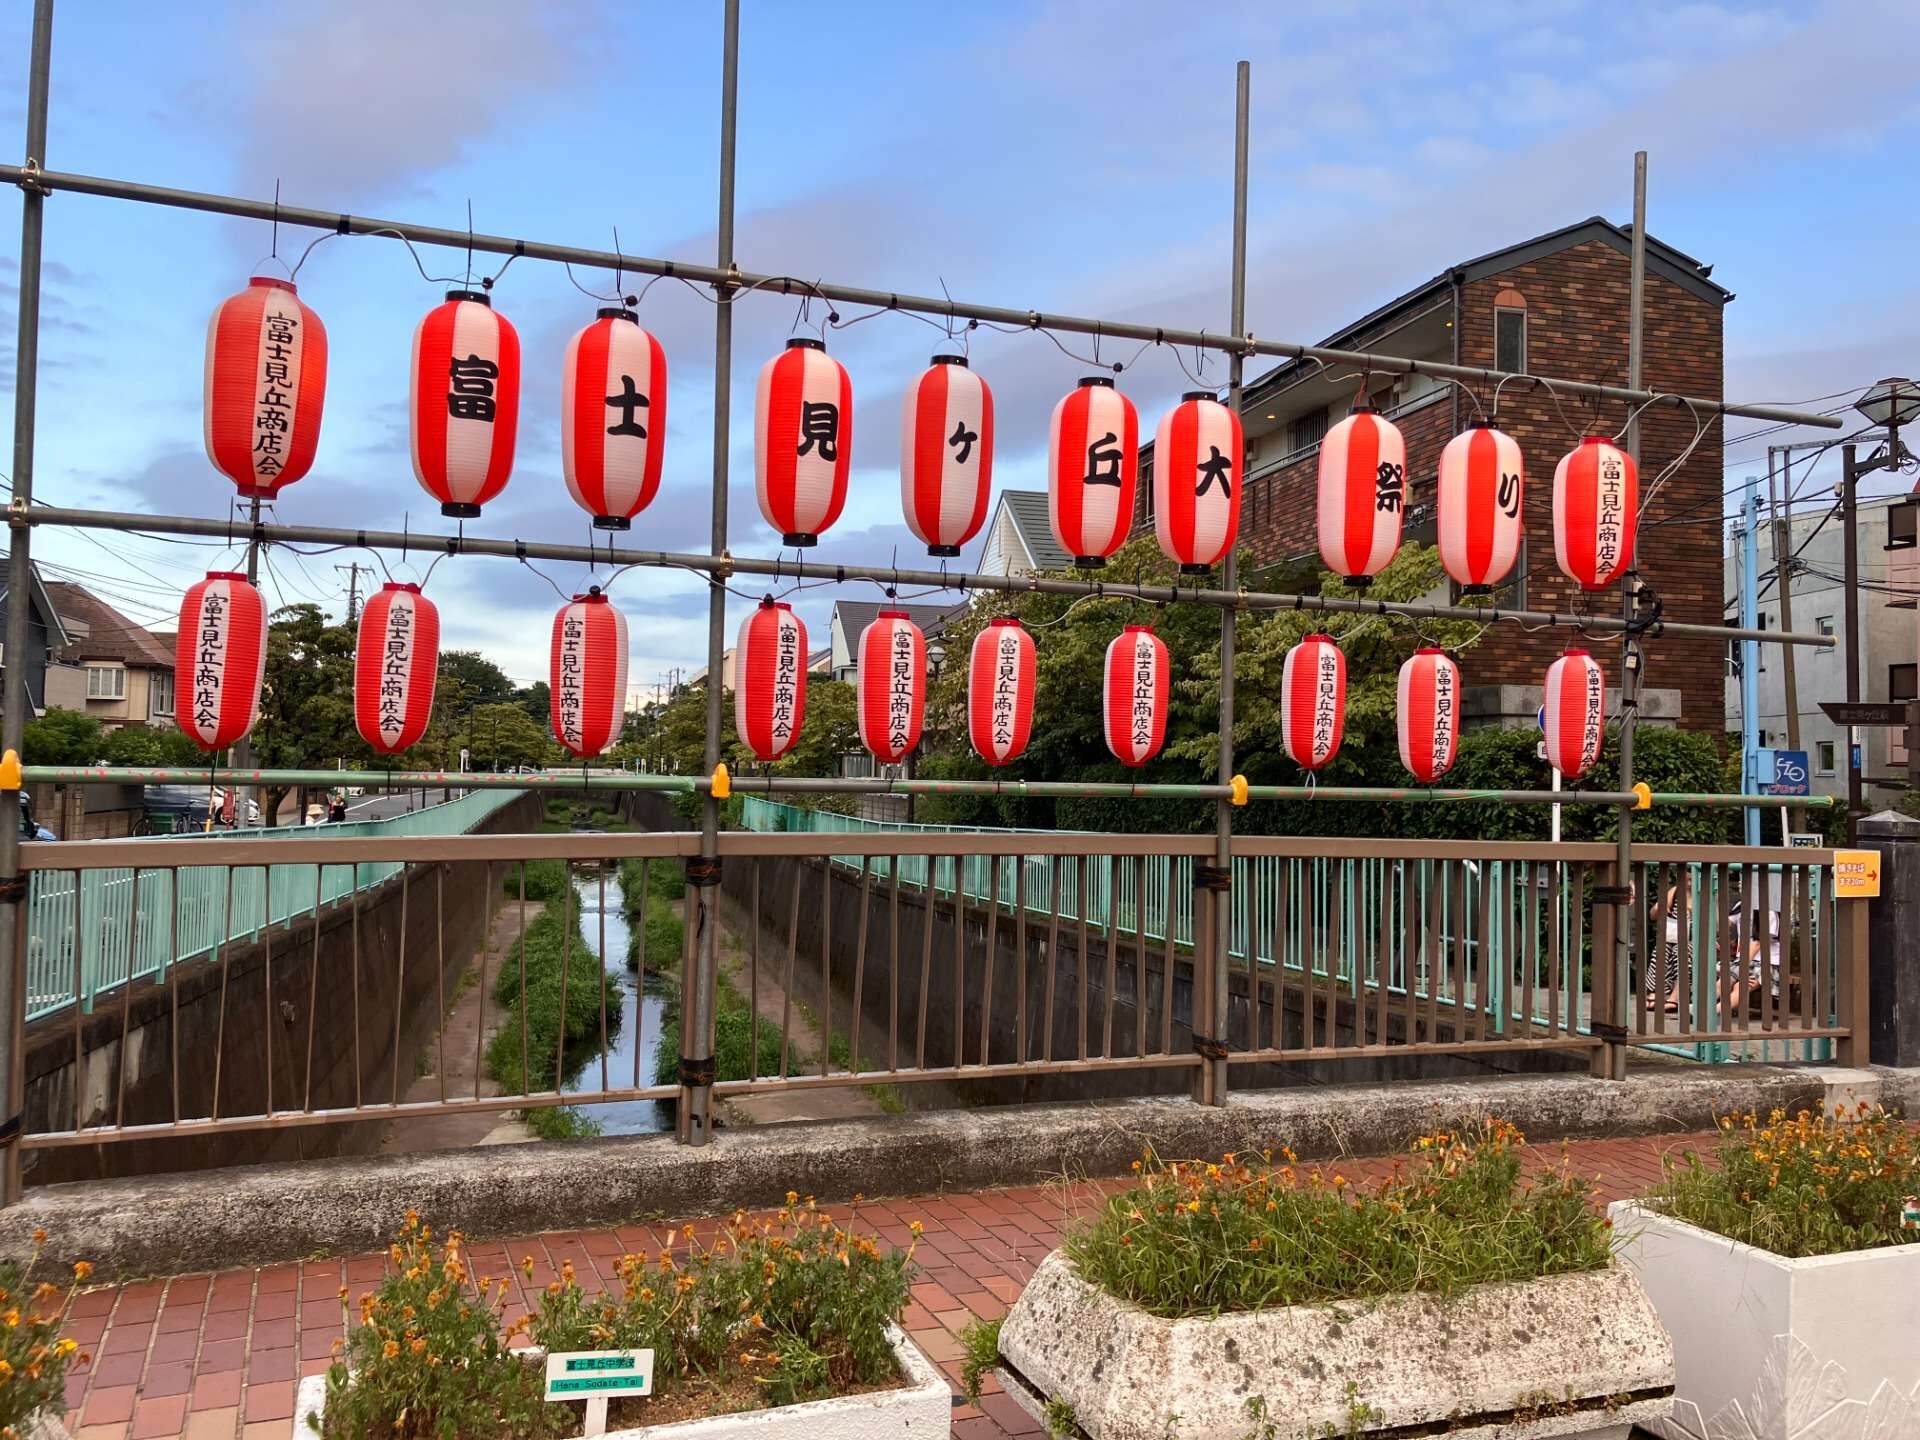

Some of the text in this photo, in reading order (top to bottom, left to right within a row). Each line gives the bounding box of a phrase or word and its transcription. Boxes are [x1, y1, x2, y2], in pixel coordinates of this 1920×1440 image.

[253, 311, 298, 477] 富士見丘商店会
[447, 353, 500, 423] 富
[604, 375, 651, 440] 士
[796, 400, 839, 463] 見
[1083, 431, 1124, 488] 丘
[1195, 444, 1233, 500] 大
[1375, 461, 1403, 514] 祭
[1497, 472, 1520, 519] り
[1595, 456, 1622, 575] 富士見丘商店会
[194, 592, 229, 730] 富士見丘商店会
[379, 604, 413, 734] 富士見丘商店会
[560, 616, 584, 744] 富士見丘商店会
[772, 623, 798, 739] 富士見丘商店会
[888, 627, 913, 749] 富士見丘商店会
[993, 635, 1019, 746] 富士見丘商店会
[1131, 641, 1154, 746] 富士見丘商店会
[1313, 654, 1336, 757] 富士見丘商店会
[1432, 666, 1452, 775] 富士見丘商店会
[1580, 667, 1601, 768] 富士見丘商店会
